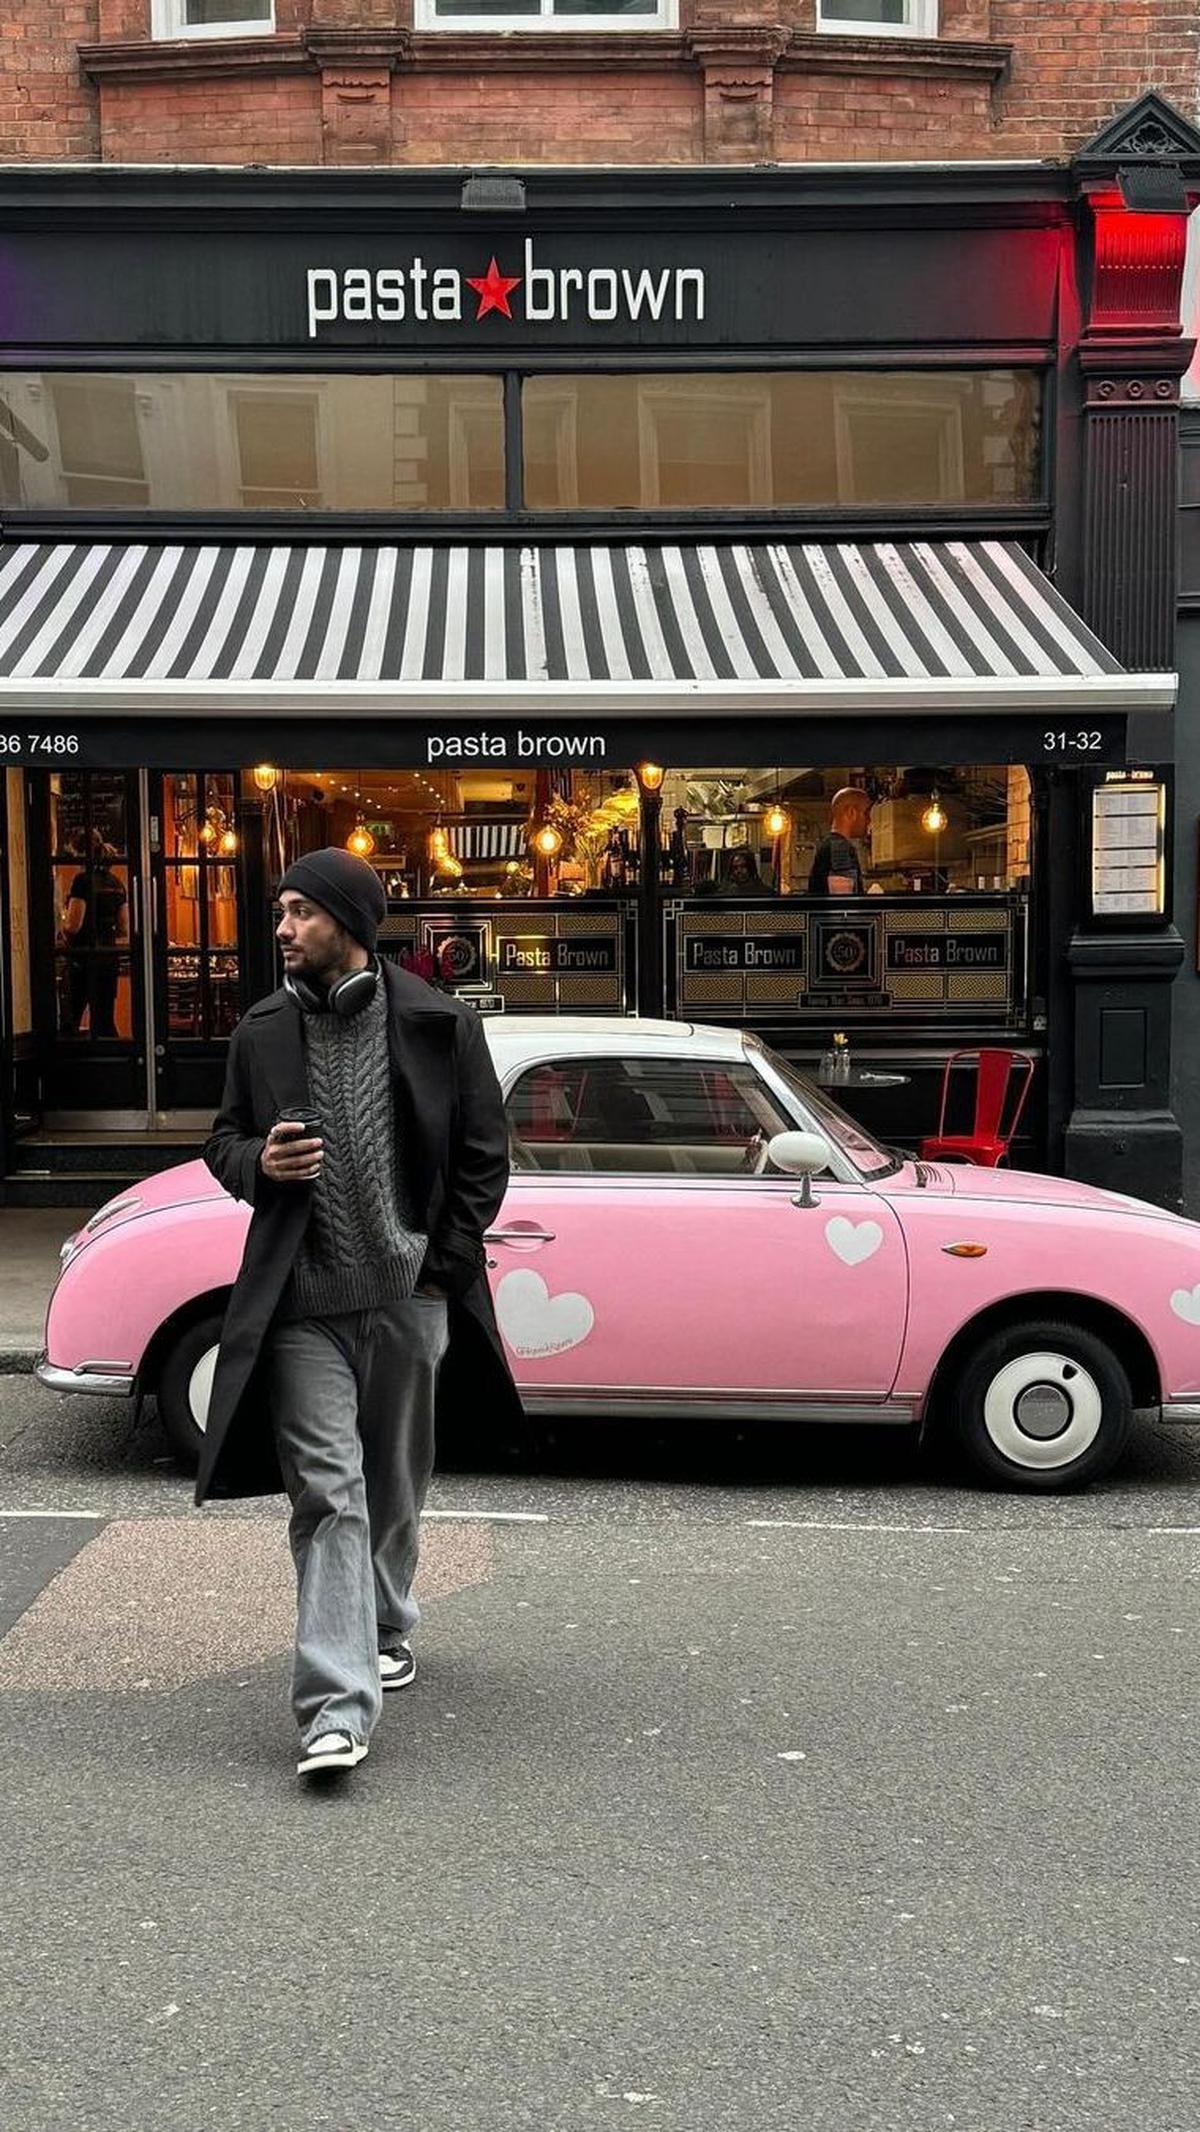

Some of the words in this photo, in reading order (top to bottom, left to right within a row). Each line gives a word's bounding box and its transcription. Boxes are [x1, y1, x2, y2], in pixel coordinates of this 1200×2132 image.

[307, 258, 462, 338] pasta
[525, 237, 705, 321] brown
[28, 734, 79, 754] 7486
[427, 732, 507, 763] pasta
[517, 730, 606, 757] brown
[1043, 731, 1102, 751] 31-32
[506, 943, 551, 967] Pasta
[557, 943, 609, 967] Brown
[693, 942, 738, 966] Pasta
[744, 941, 796, 965] Brown
[894, 940, 940, 963] Pasta
[946, 939, 997, 963] Brown
